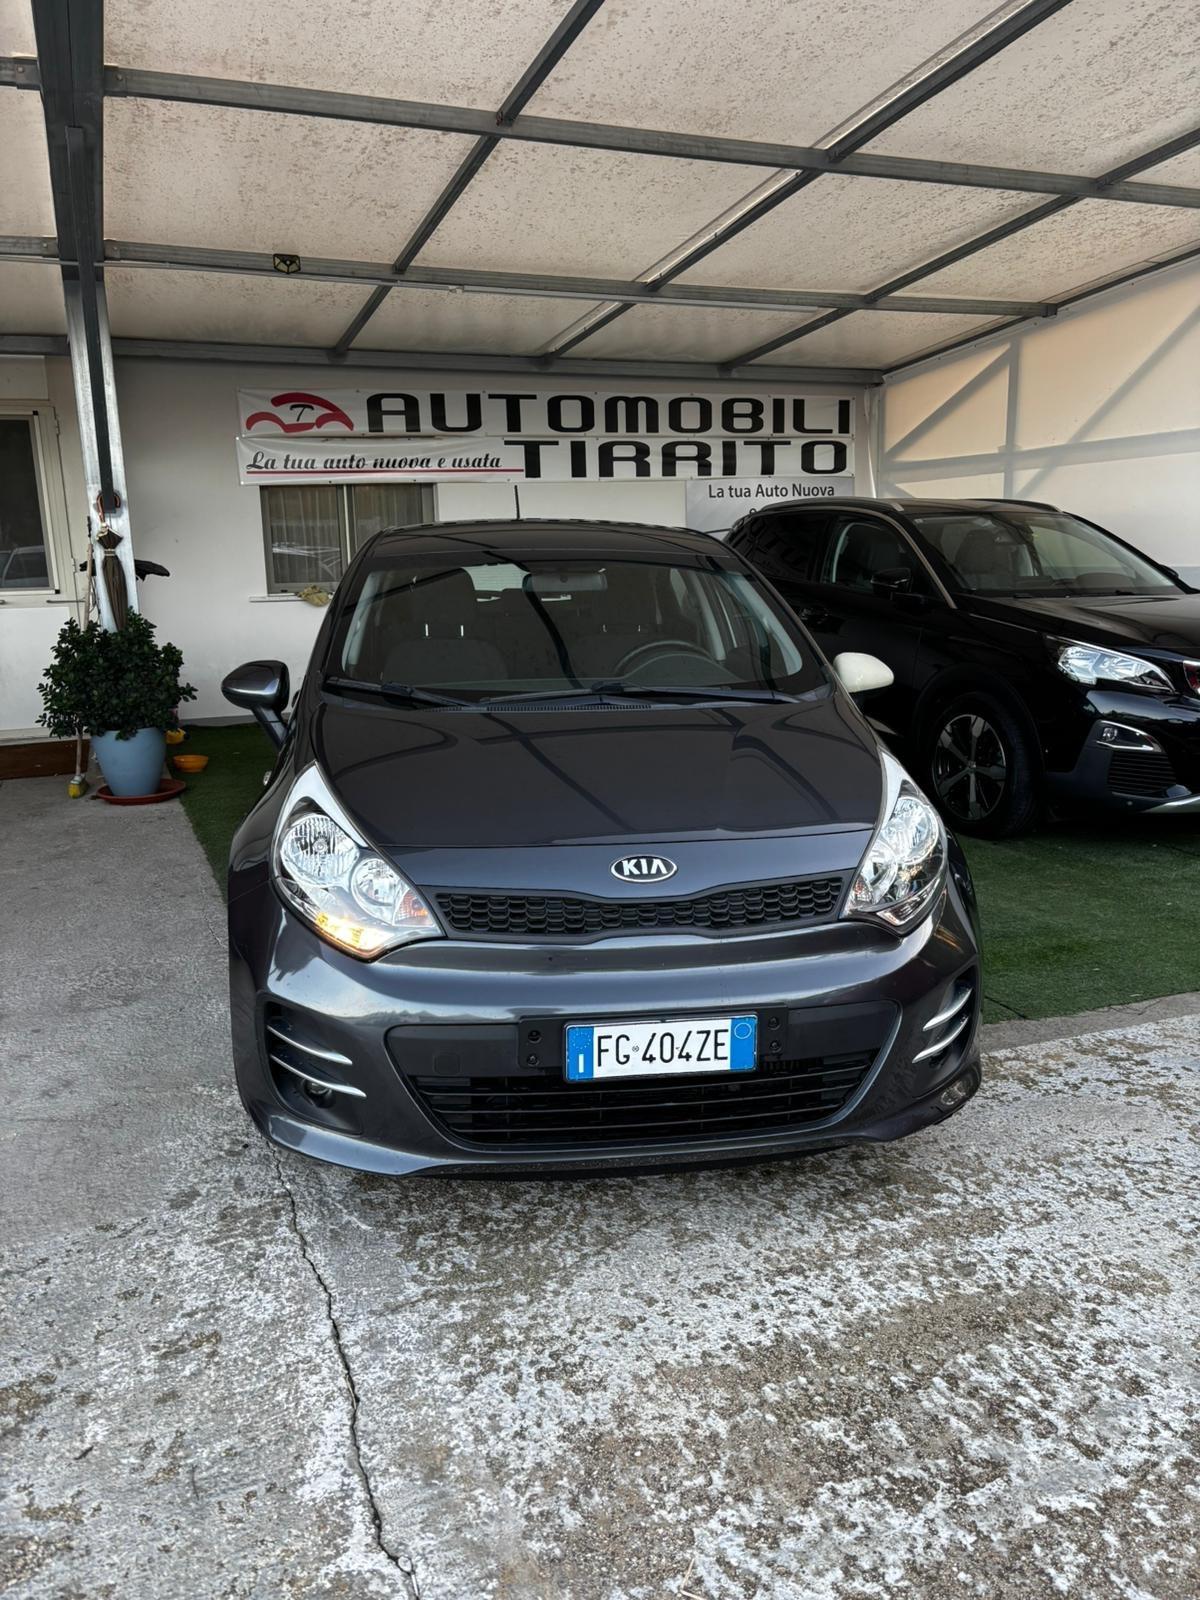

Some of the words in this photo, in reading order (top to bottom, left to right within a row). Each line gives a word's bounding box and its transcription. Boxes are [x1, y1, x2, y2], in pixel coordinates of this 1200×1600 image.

[366, 393, 850, 434] AUTOMOBILI
[246, 451, 277, 470] La
[283, 454, 316, 470] tua
[323, 454, 366, 469] auto
[372, 457, 431, 469] nuova
[437, 456, 446, 468] e
[451, 453, 501, 468] usata
[503, 440, 848, 478] TIRRITO
[708, 484, 725, 498] La
[729, 485, 751, 498] tua
[755, 484, 789, 498] Auto
[792, 483, 835, 497] Nuova
[621, 858, 668, 876] KIA
